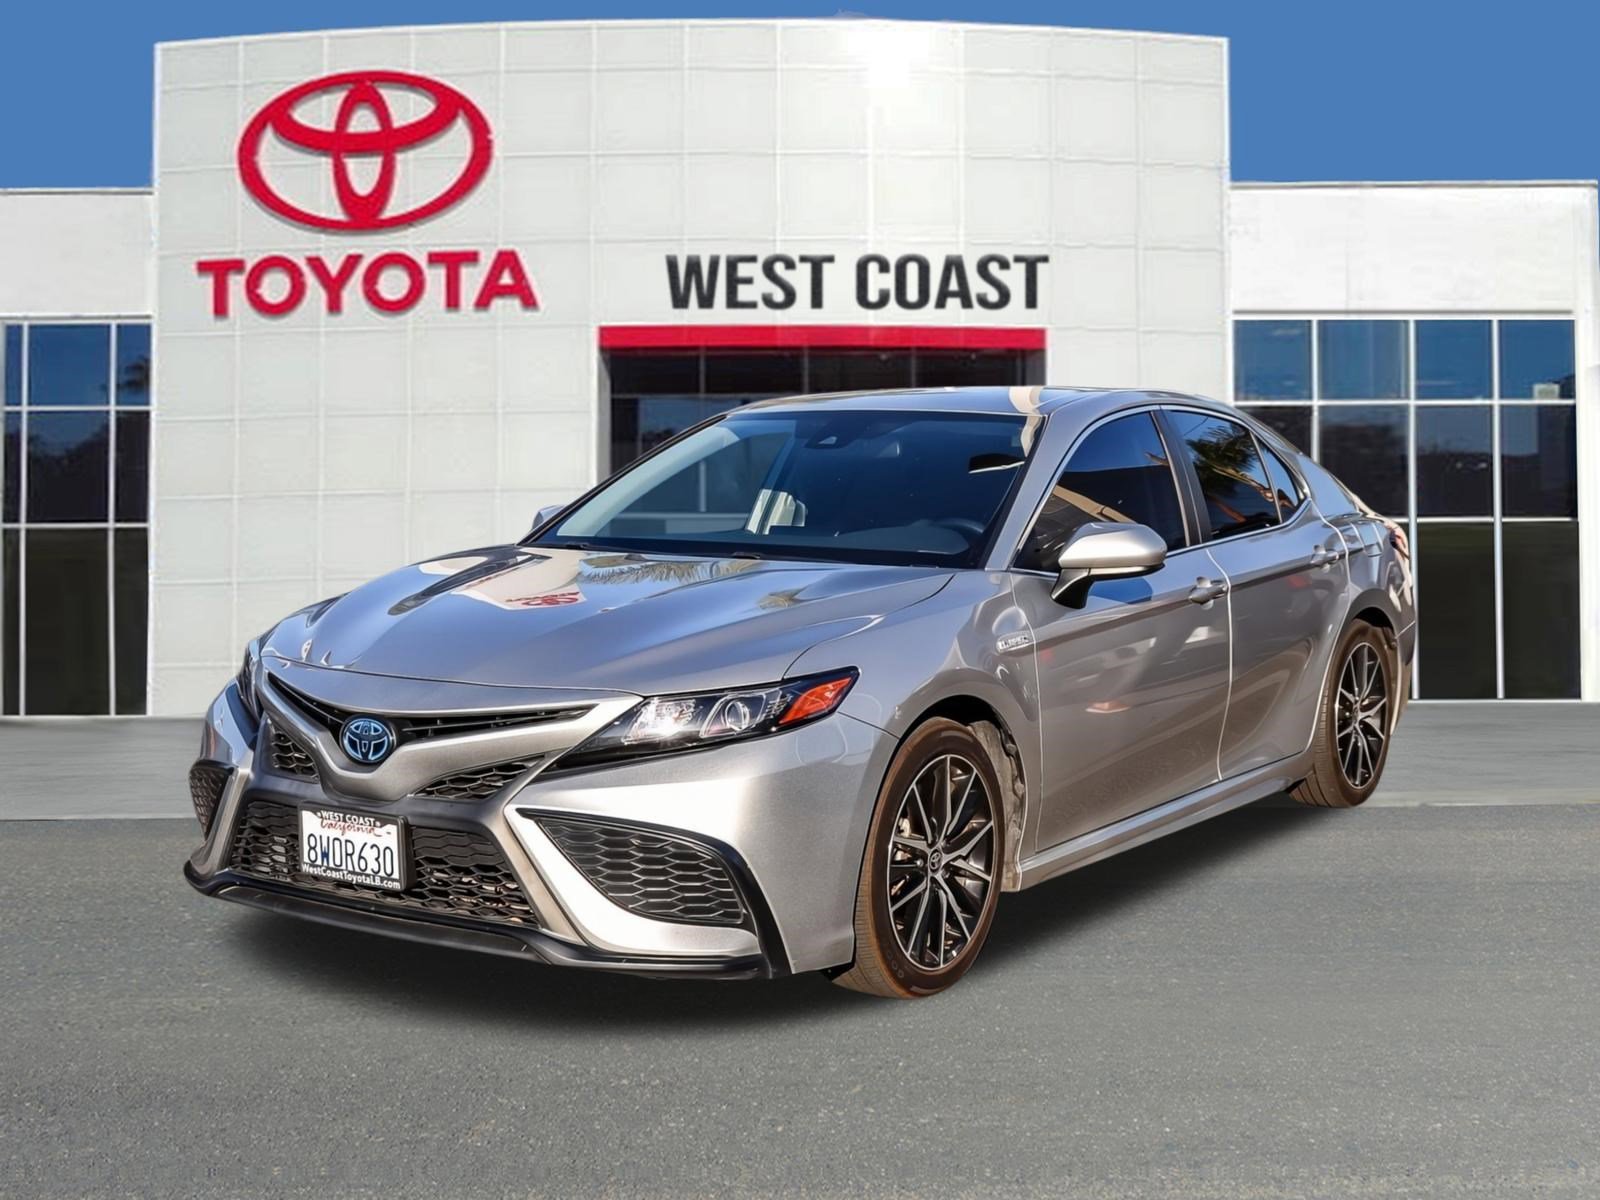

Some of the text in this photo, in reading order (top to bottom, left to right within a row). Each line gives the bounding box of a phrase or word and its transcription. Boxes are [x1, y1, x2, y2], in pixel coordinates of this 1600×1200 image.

[197, 250, 539, 318] TOYOTA
[665, 253, 1050, 311] WEST COAST
[320, 810, 376, 827] WEST COAST
[301, 862, 401, 889] WestCoastToyotaLB.com
